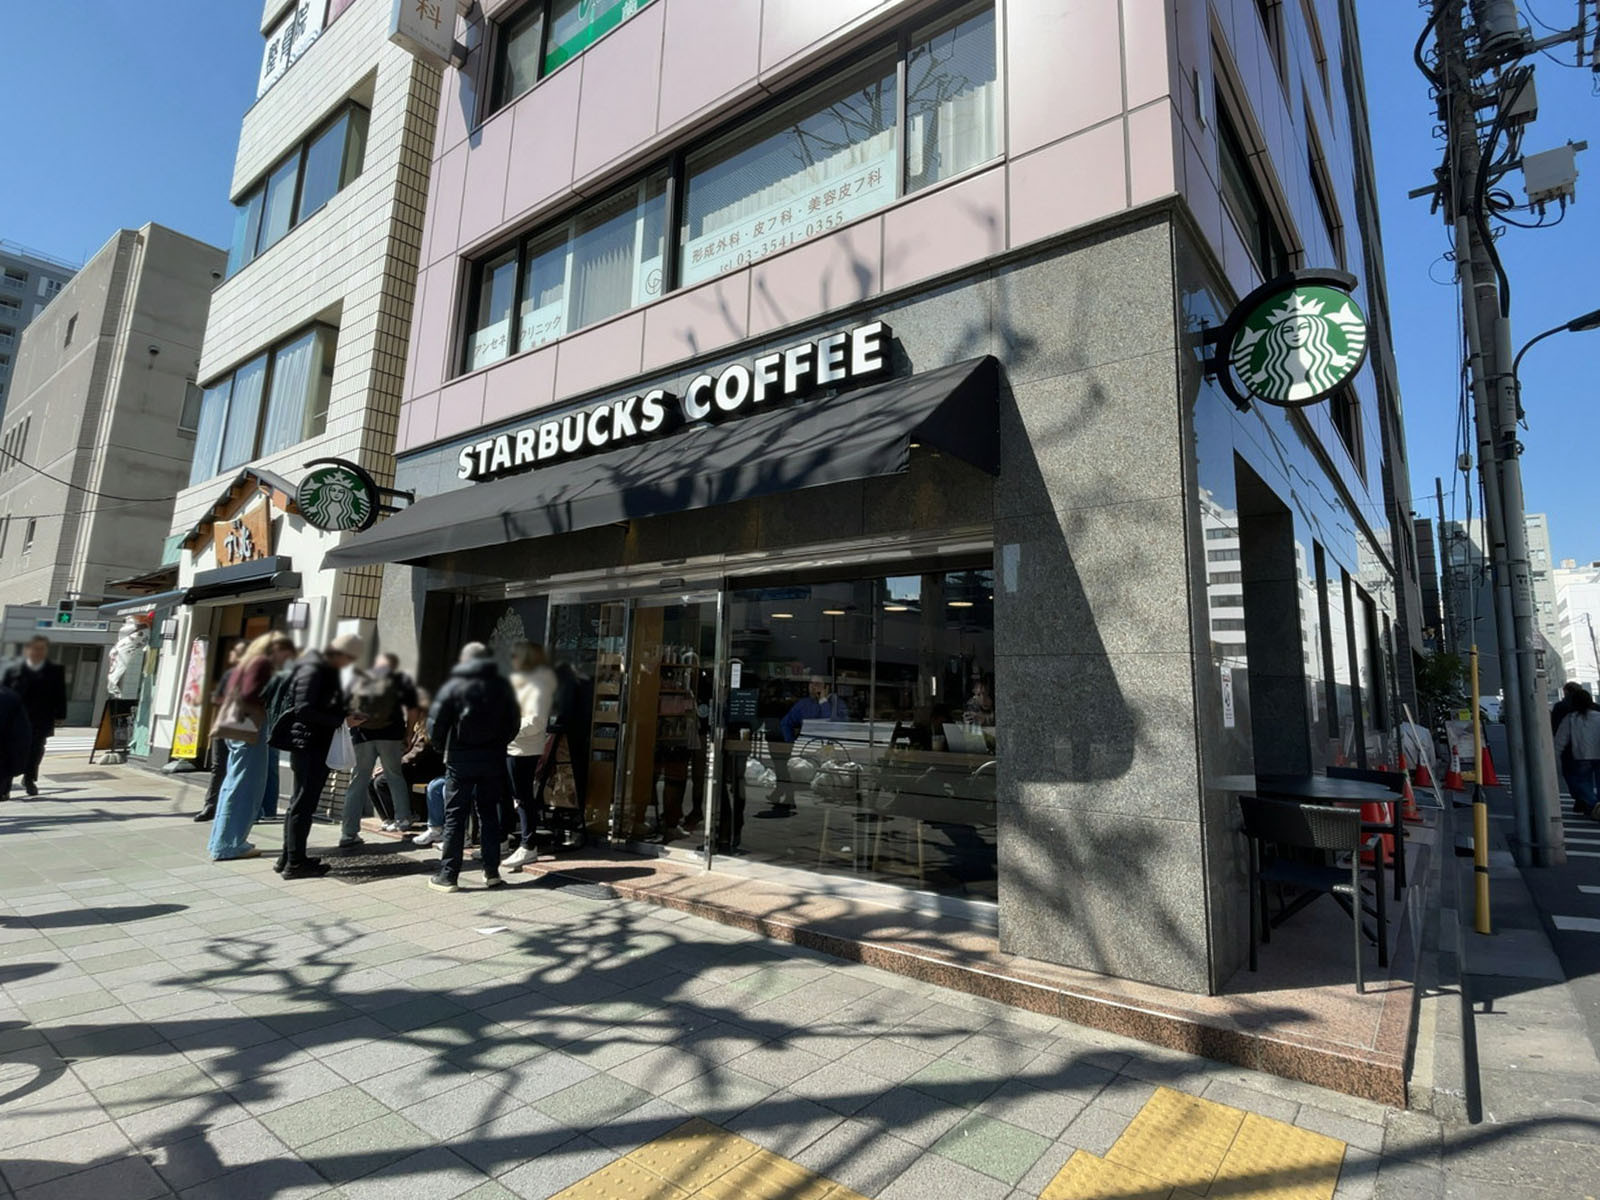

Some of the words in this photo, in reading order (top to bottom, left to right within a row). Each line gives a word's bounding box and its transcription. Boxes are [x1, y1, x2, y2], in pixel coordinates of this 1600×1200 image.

[737, 211, 844, 267] 03-3541-0355
[457, 389, 666, 480] STARBUCKS
[684, 320, 884, 420] COFFEE
